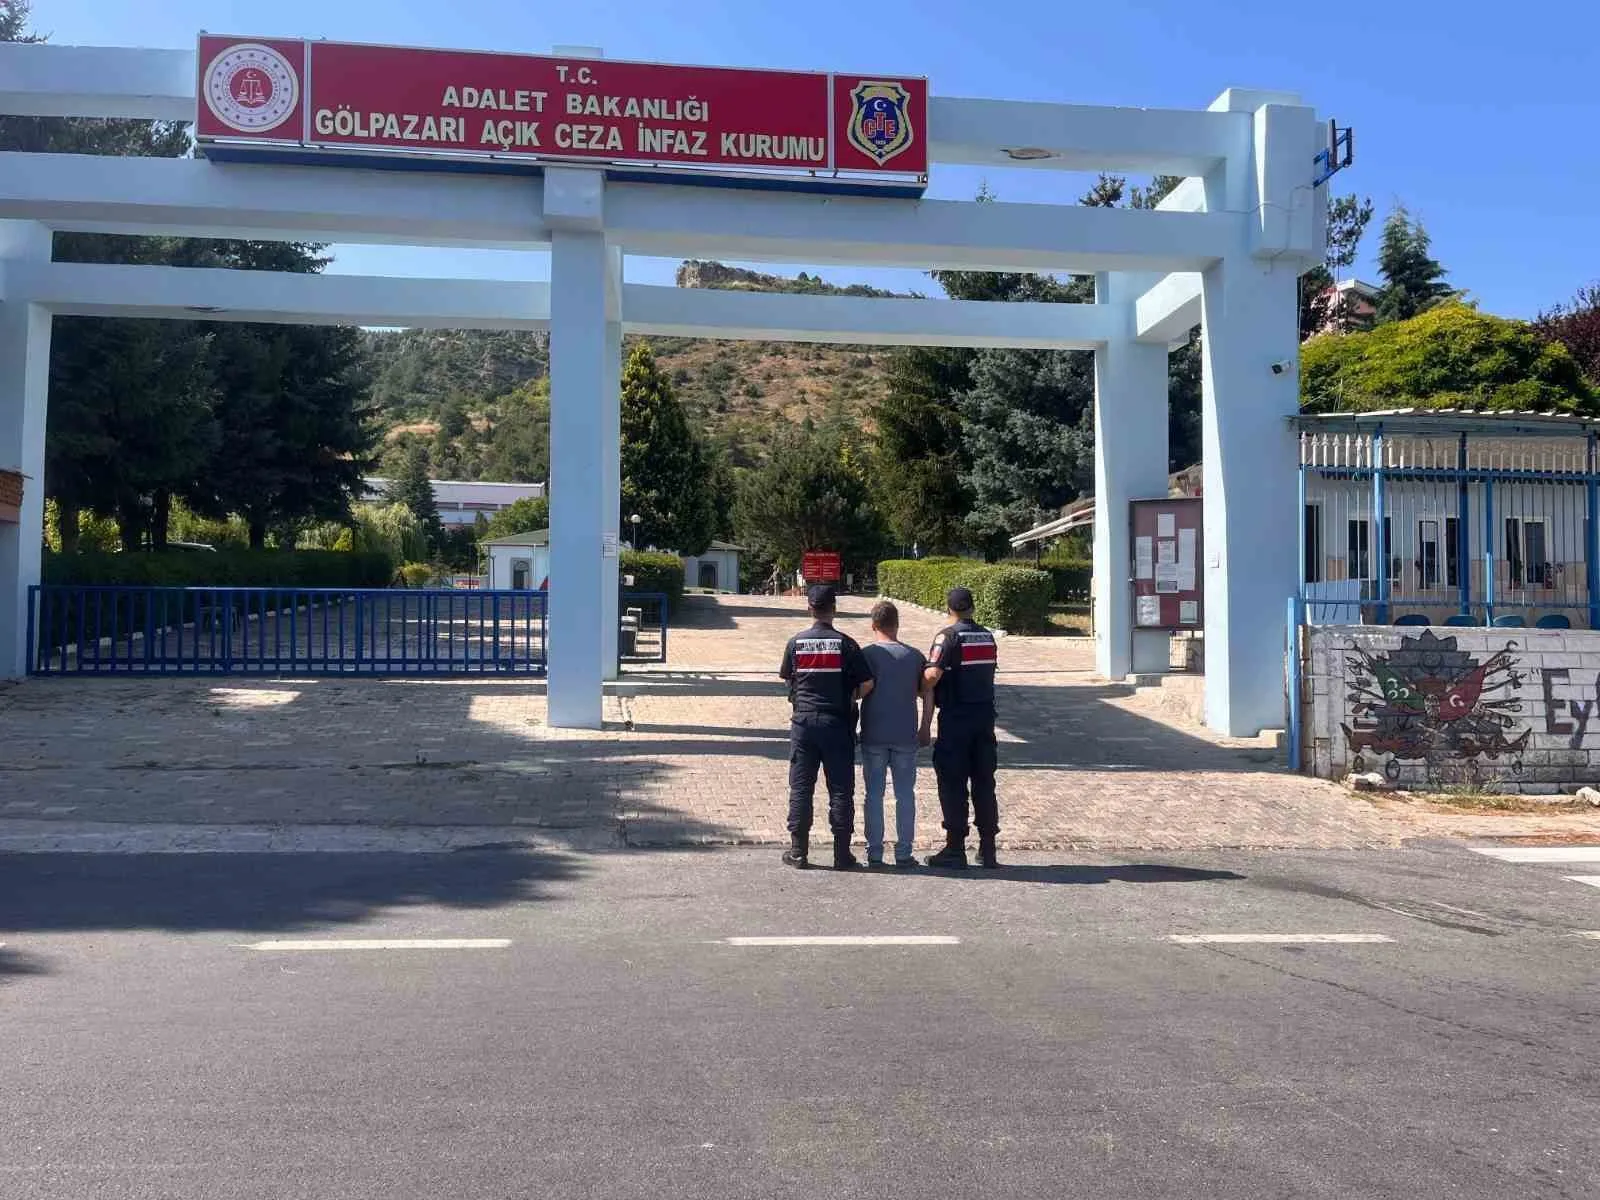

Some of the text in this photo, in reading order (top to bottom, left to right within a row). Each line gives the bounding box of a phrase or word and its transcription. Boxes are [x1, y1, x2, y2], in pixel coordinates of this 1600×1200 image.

[556, 66, 599, 85] T.C.
[442, 86, 709, 122] ADALET BAKANLIĞI
[315, 105, 825, 161] GÖLPAZARI AÇIK CEZA İNFAZ KURUMU
